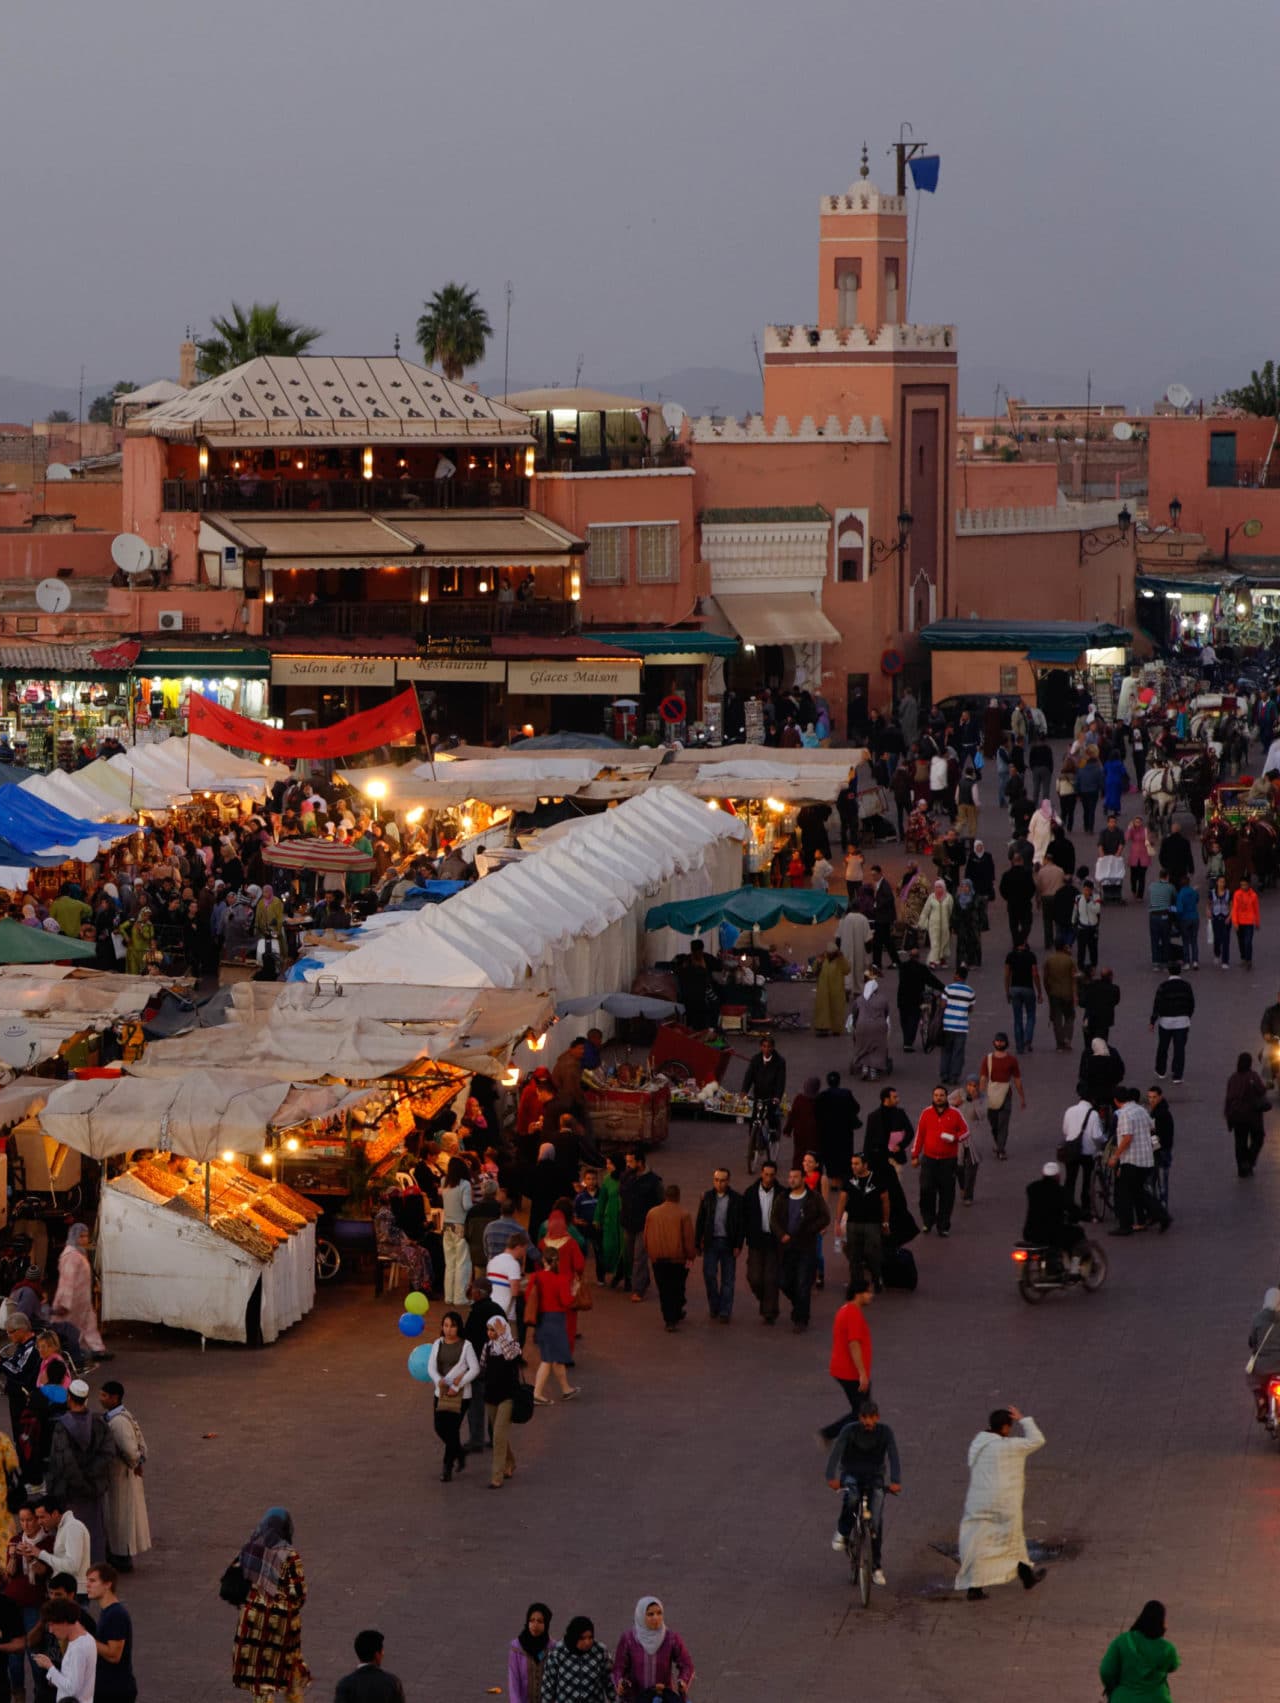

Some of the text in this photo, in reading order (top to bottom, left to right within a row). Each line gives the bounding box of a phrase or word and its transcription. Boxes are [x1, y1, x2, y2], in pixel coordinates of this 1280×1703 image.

[290, 662, 327, 674] Salon
[332, 663, 346, 674] de
[418, 660, 488, 670] Restaurant
[529, 670, 618, 686] Glaces Maison
